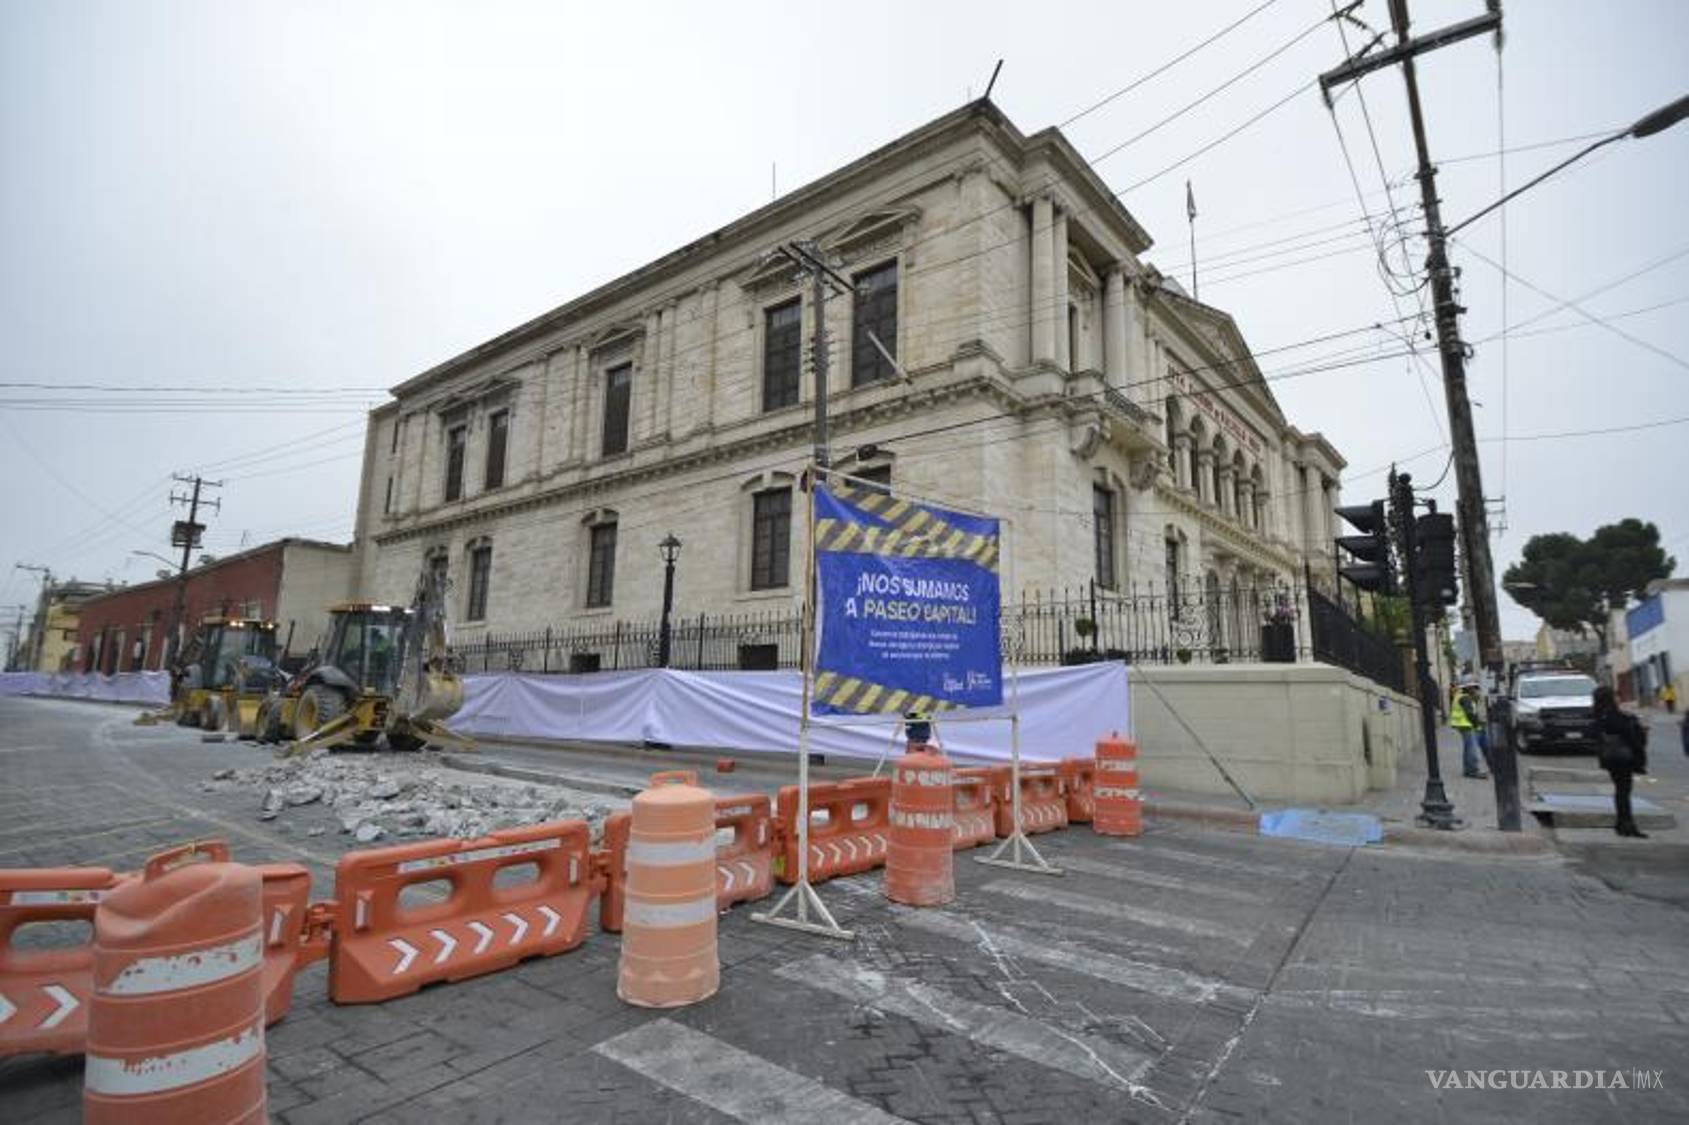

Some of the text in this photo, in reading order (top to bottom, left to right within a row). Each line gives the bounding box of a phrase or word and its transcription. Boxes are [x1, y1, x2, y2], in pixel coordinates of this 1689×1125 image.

[856, 572, 900, 596] ¡NOS
[845, 597, 857, 618] A
[863, 598, 921, 621] PASEO
